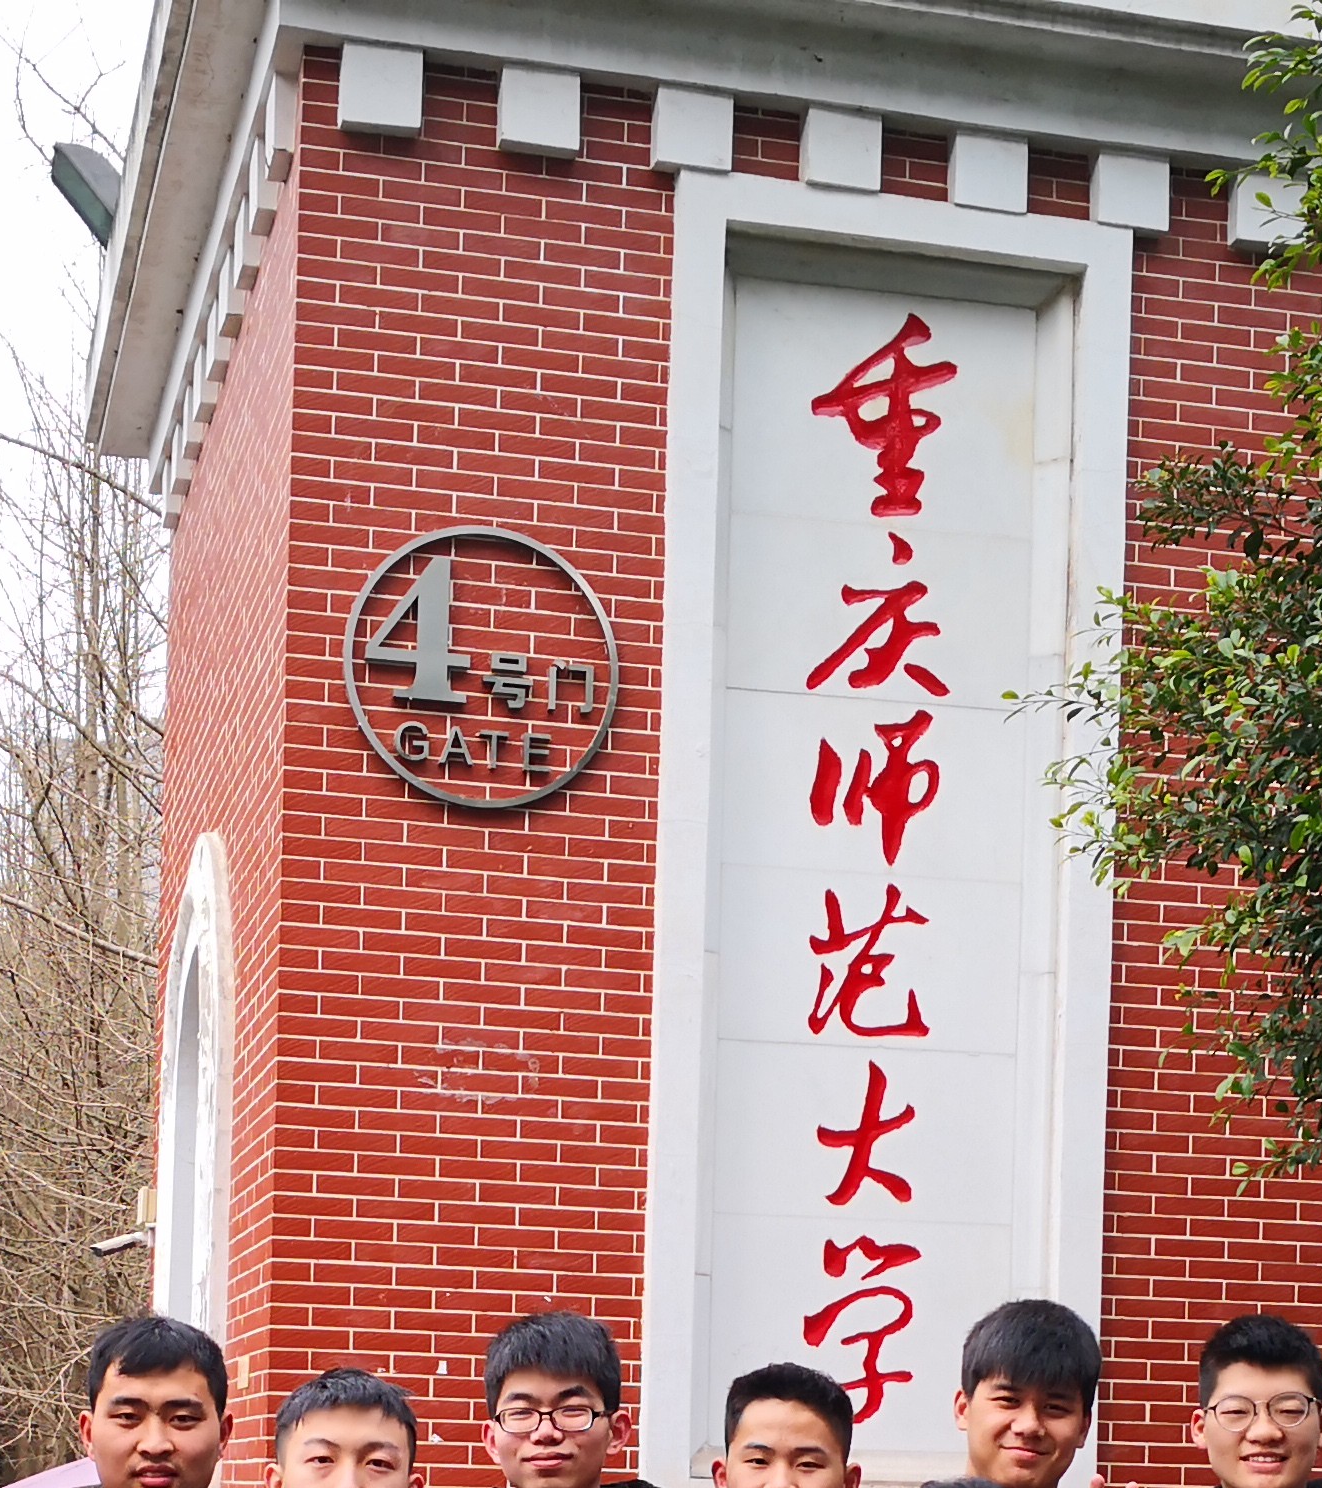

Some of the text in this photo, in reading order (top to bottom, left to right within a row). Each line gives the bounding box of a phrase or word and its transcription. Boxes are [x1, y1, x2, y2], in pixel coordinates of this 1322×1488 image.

[365, 555, 595, 714] 4号门
[394, 720, 552, 773] GATE
[802, 312, 958, 1425] 重庆师范大学
